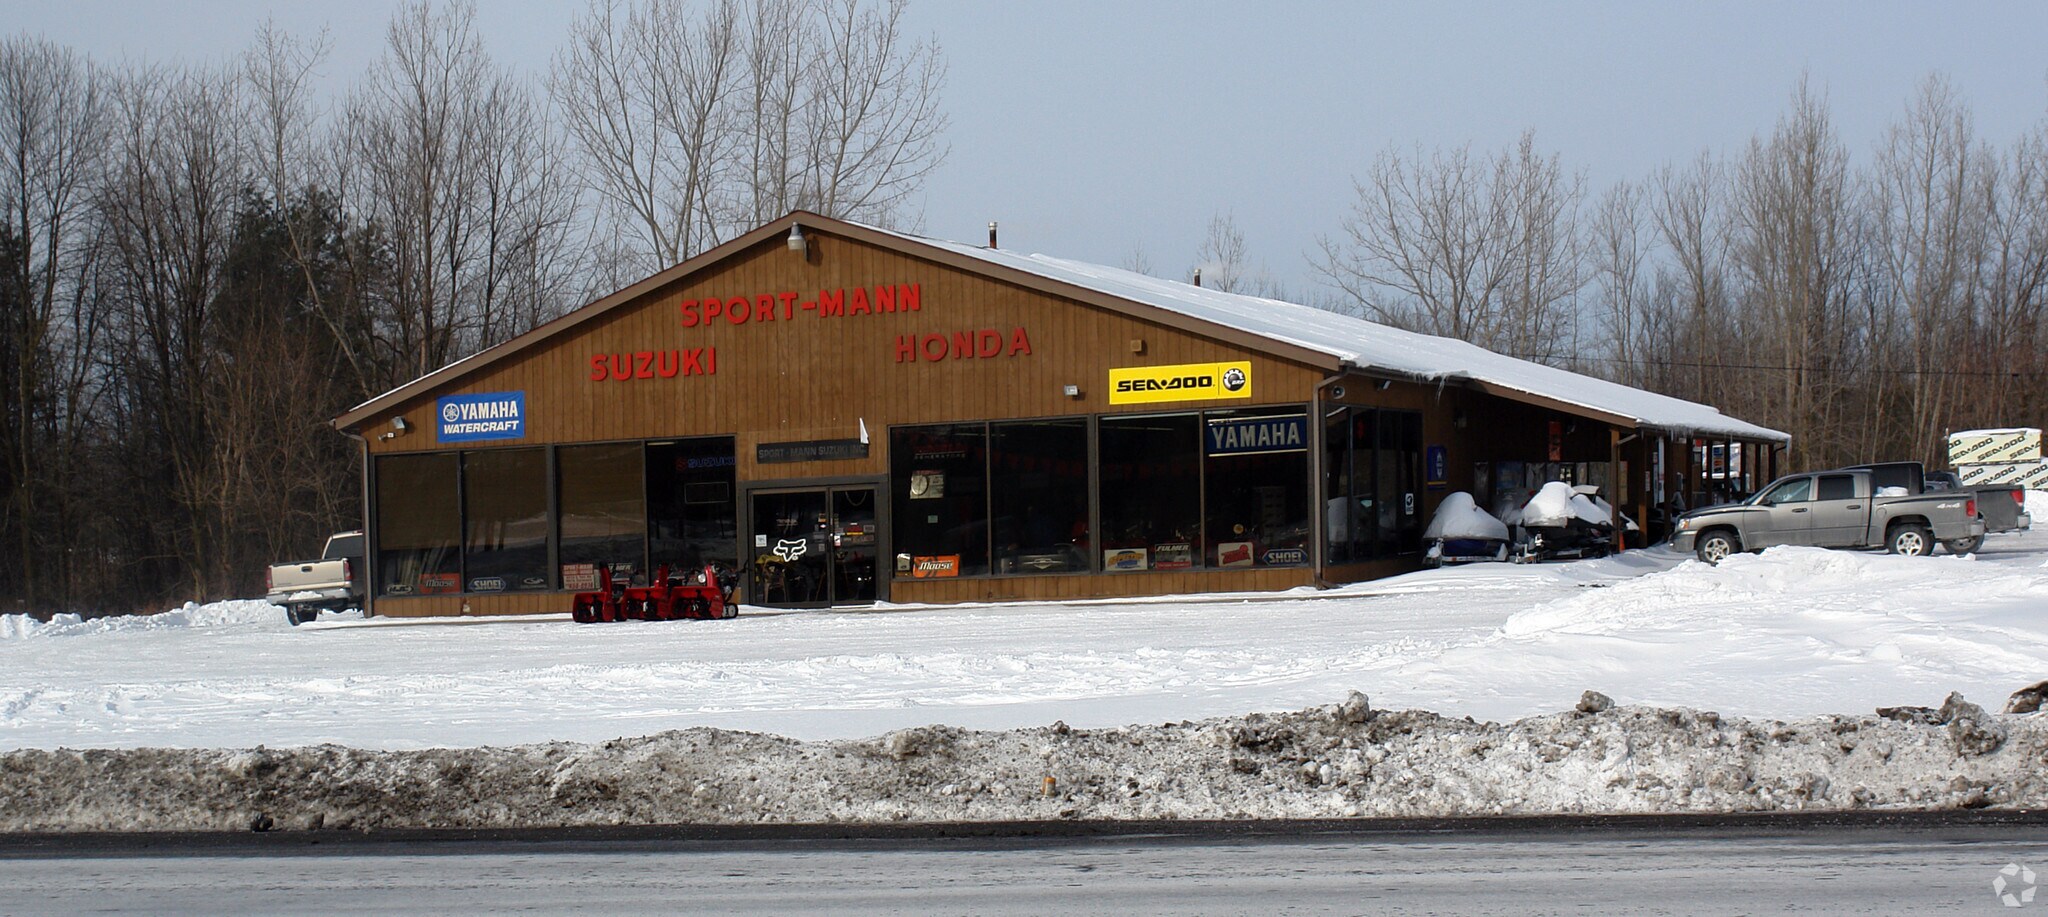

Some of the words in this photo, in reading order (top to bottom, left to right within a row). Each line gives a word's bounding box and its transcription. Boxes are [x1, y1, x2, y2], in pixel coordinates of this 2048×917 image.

[680, 283, 921, 327] SPORT-MANN
[896, 327, 1032, 364] HONDA
[590, 347, 717, 381] SUZUKI
[460, 401, 519, 420] YAMAHA
[444, 420, 519, 435] WATERCRAFT
[1212, 422, 1301, 449] YAMAHA
[818, 444, 848, 455] SUZUKI
[1156, 544, 1189, 552] FULMER
[1268, 551, 1302, 564] SHOEI
